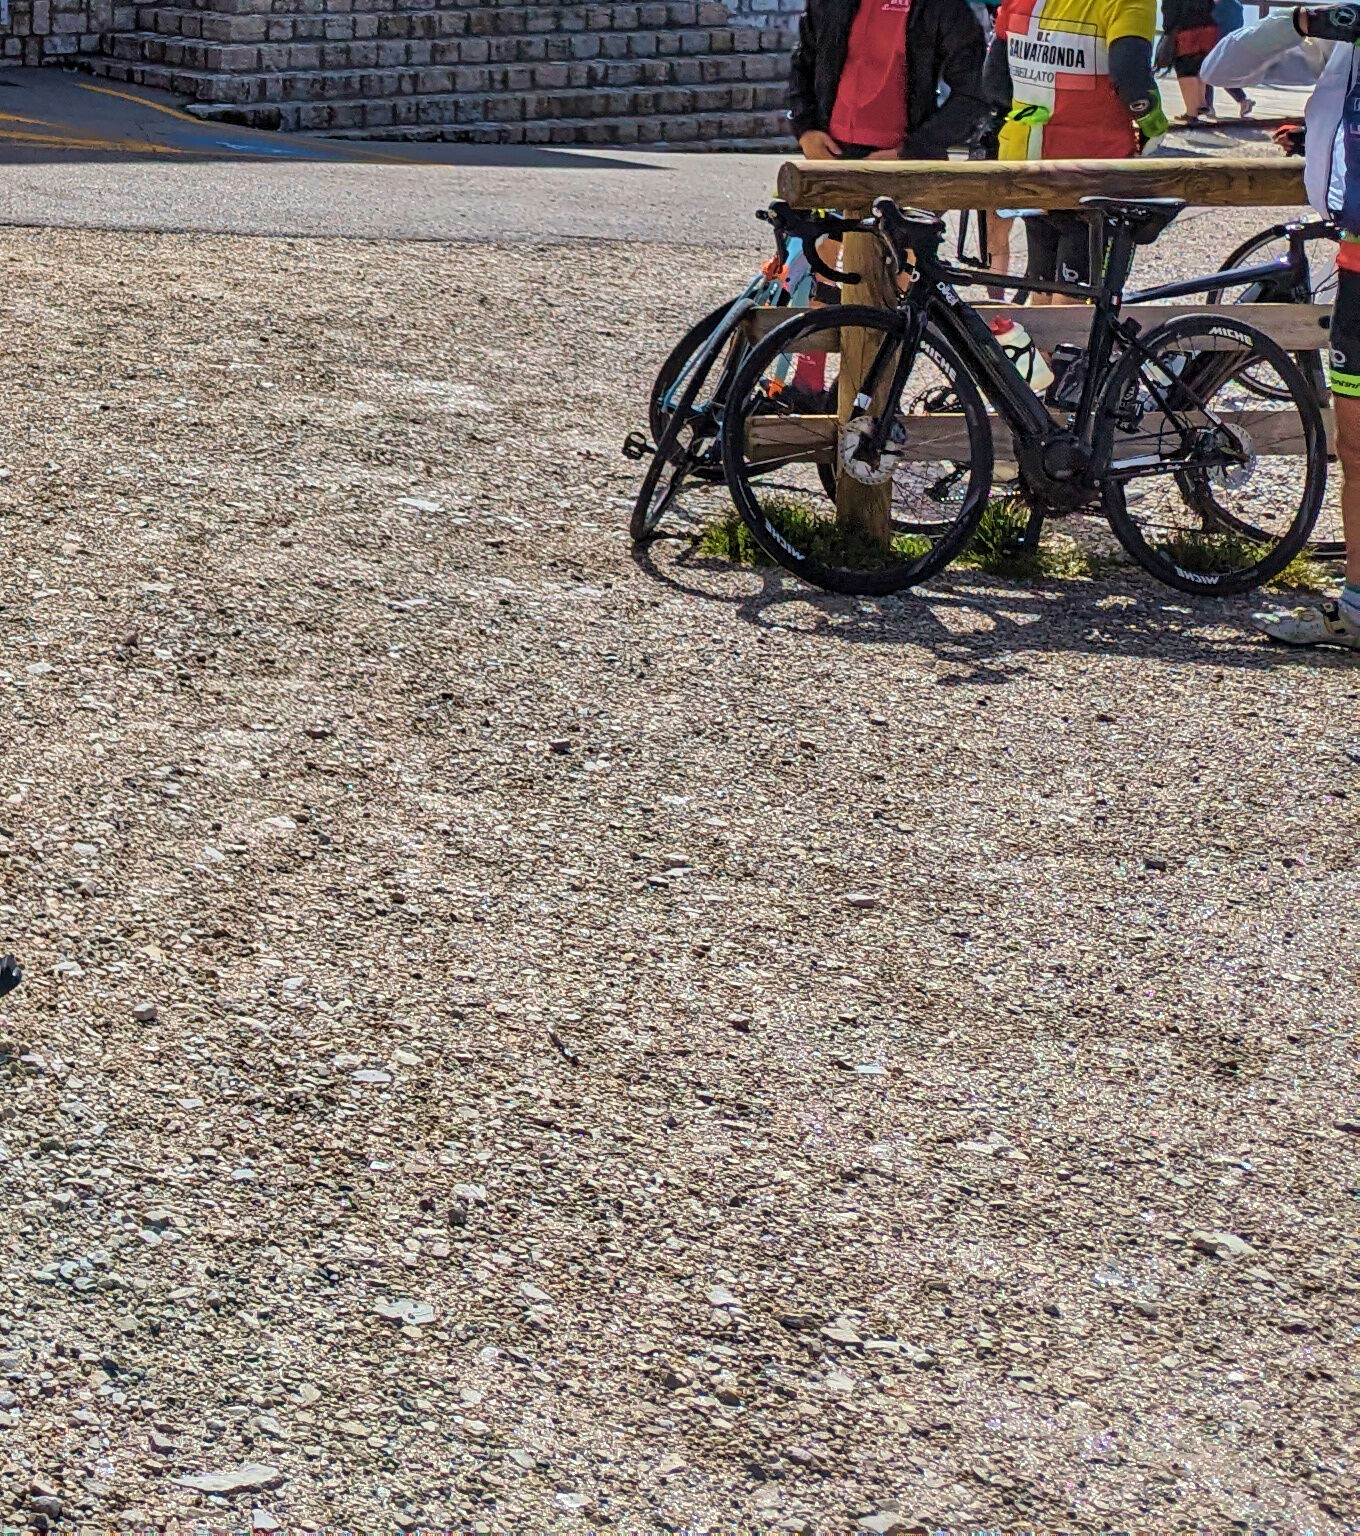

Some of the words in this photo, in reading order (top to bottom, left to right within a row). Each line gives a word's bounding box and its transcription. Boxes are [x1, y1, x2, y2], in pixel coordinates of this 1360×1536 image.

[1009, 37, 1086, 69] SALVATRONDA
[1208, 326, 1254, 347] MICHE
[920, 340, 957, 383] MICHE
